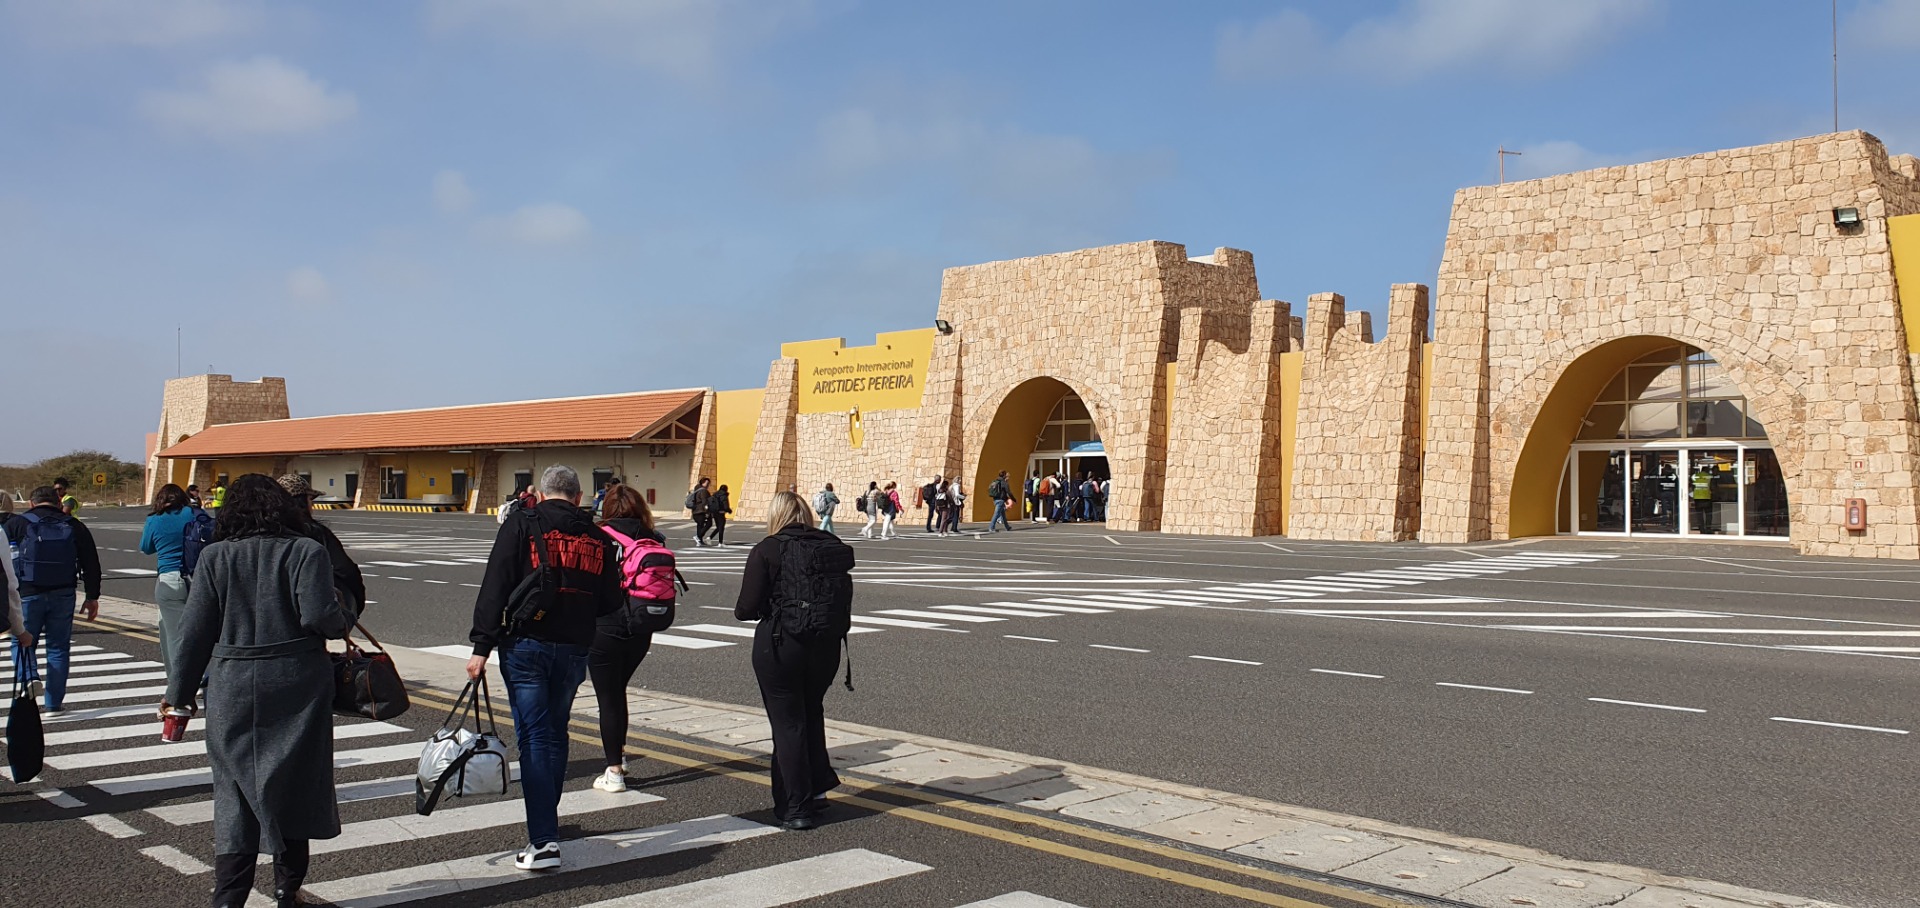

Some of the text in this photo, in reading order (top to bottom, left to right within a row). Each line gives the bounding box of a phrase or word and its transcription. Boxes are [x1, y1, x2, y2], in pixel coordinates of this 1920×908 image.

[813, 358, 914, 377] Aeroporto Internacional
[813, 374, 914, 394] ARISTIDES PEREIRA
[96, 474, 103, 483] C
